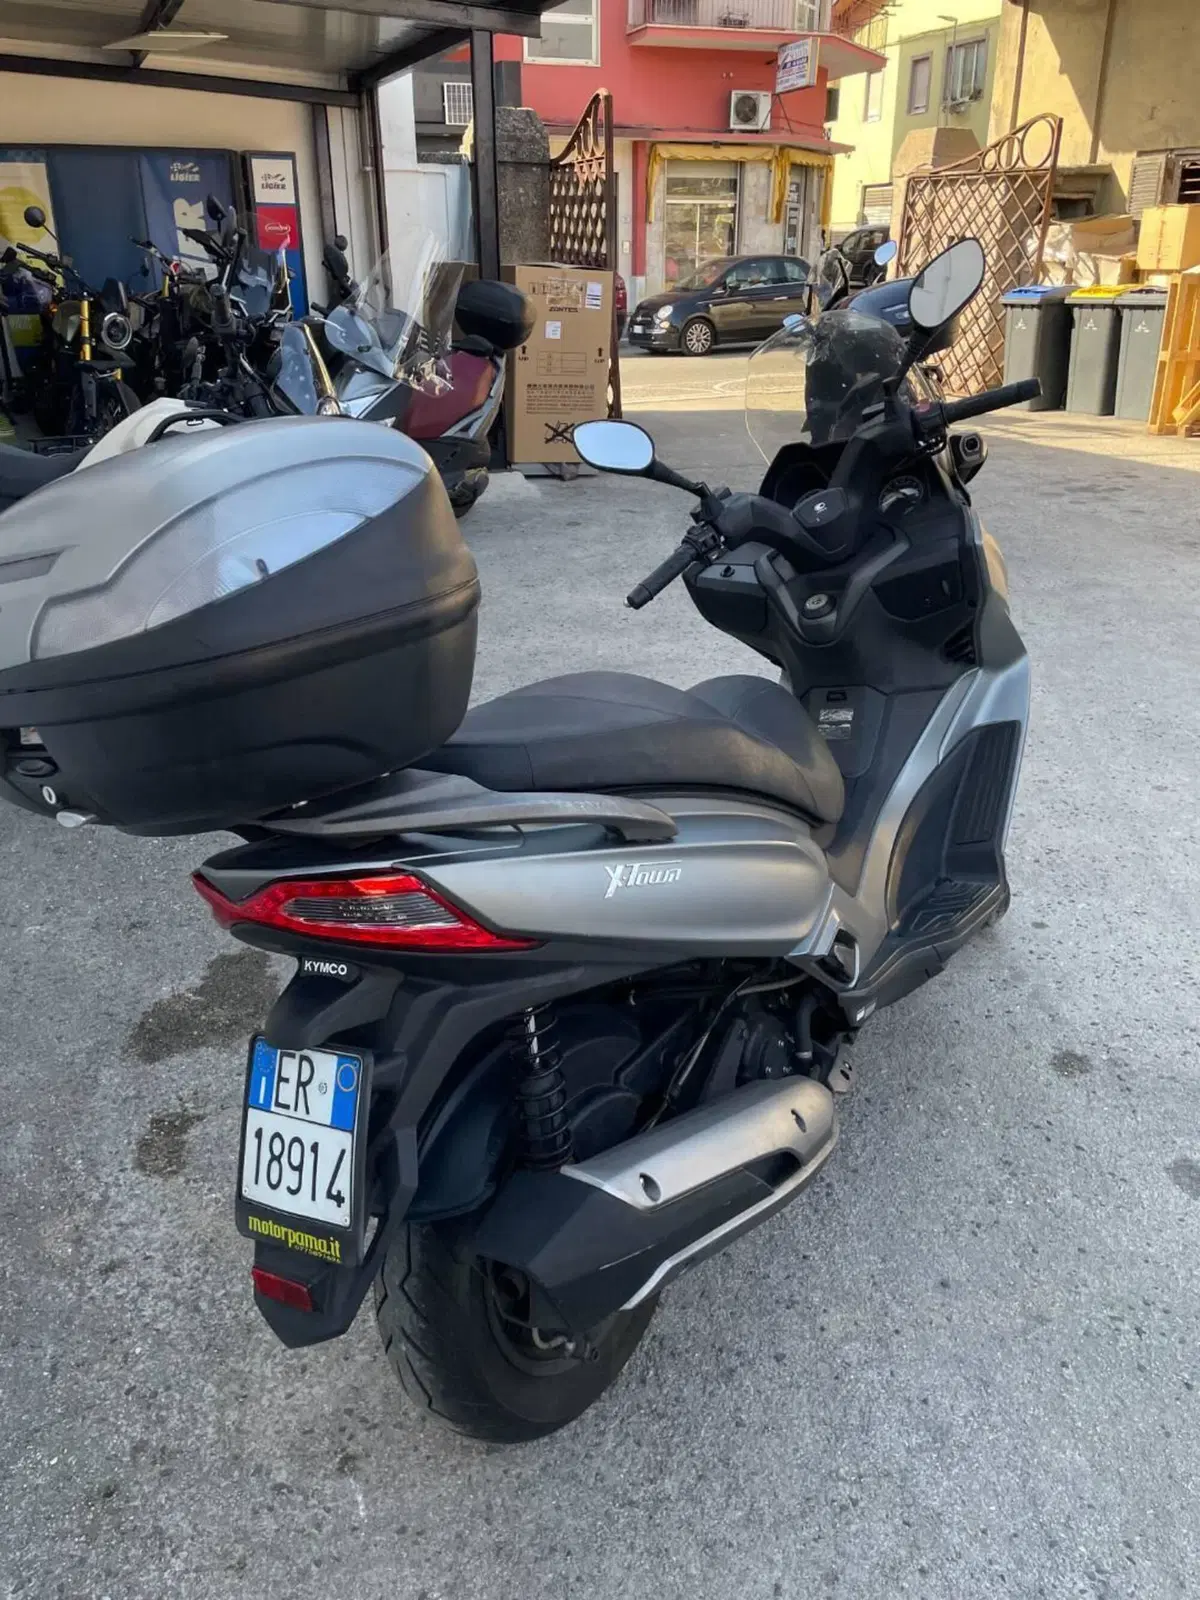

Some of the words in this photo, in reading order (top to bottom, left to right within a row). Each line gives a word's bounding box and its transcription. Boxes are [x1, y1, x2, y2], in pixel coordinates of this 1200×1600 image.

[261, 182, 287, 190] LIGIER
[303, 959, 348, 976] KYMCO
[274, 1050, 316, 1116] ER
[253, 1126, 347, 1209] 18914
[248, 1215, 342, 1259] motorpama.it
